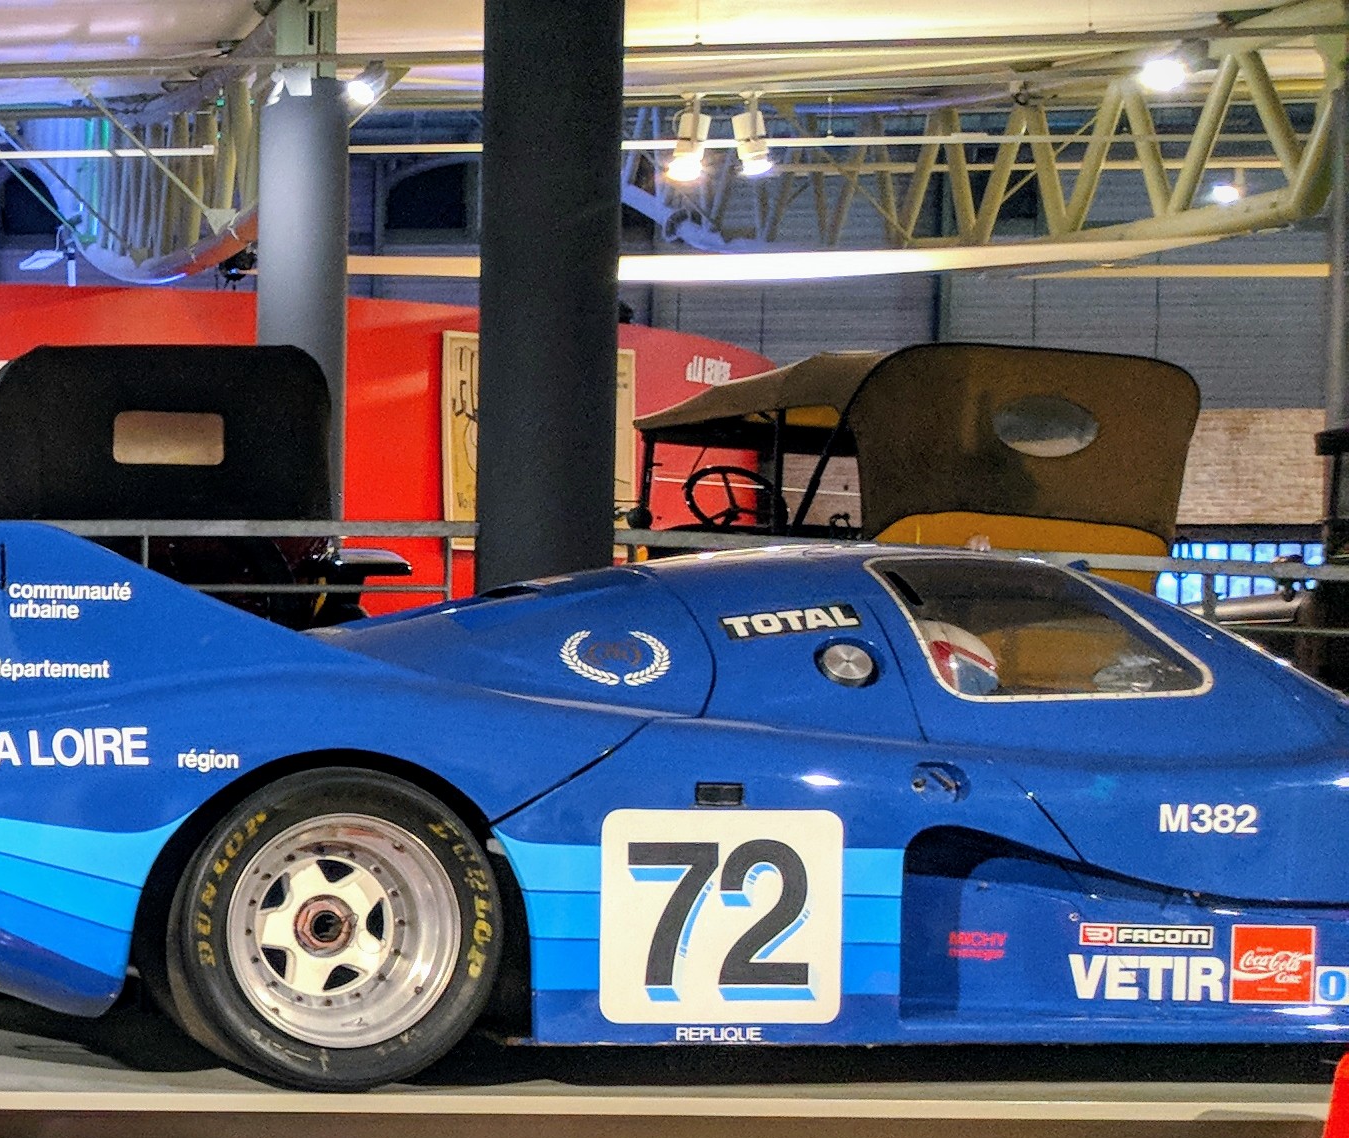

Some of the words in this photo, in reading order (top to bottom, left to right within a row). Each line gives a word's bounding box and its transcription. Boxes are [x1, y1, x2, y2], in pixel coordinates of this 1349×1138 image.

[8, 582, 131, 602] communauté
[9, 601, 79, 619] urbaine
[730, 606, 858, 636] TOTAL
[30, 727, 149, 766] LOIRE
[177, 749, 239, 773] région
[1159, 803, 1258, 834] M382
[627, 839, 816, 1002] 72
[1116, 929, 1209, 944] FACOM
[1068, 954, 1225, 1001] VETIR
[675, 1026, 763, 1042] REPLIQUE
